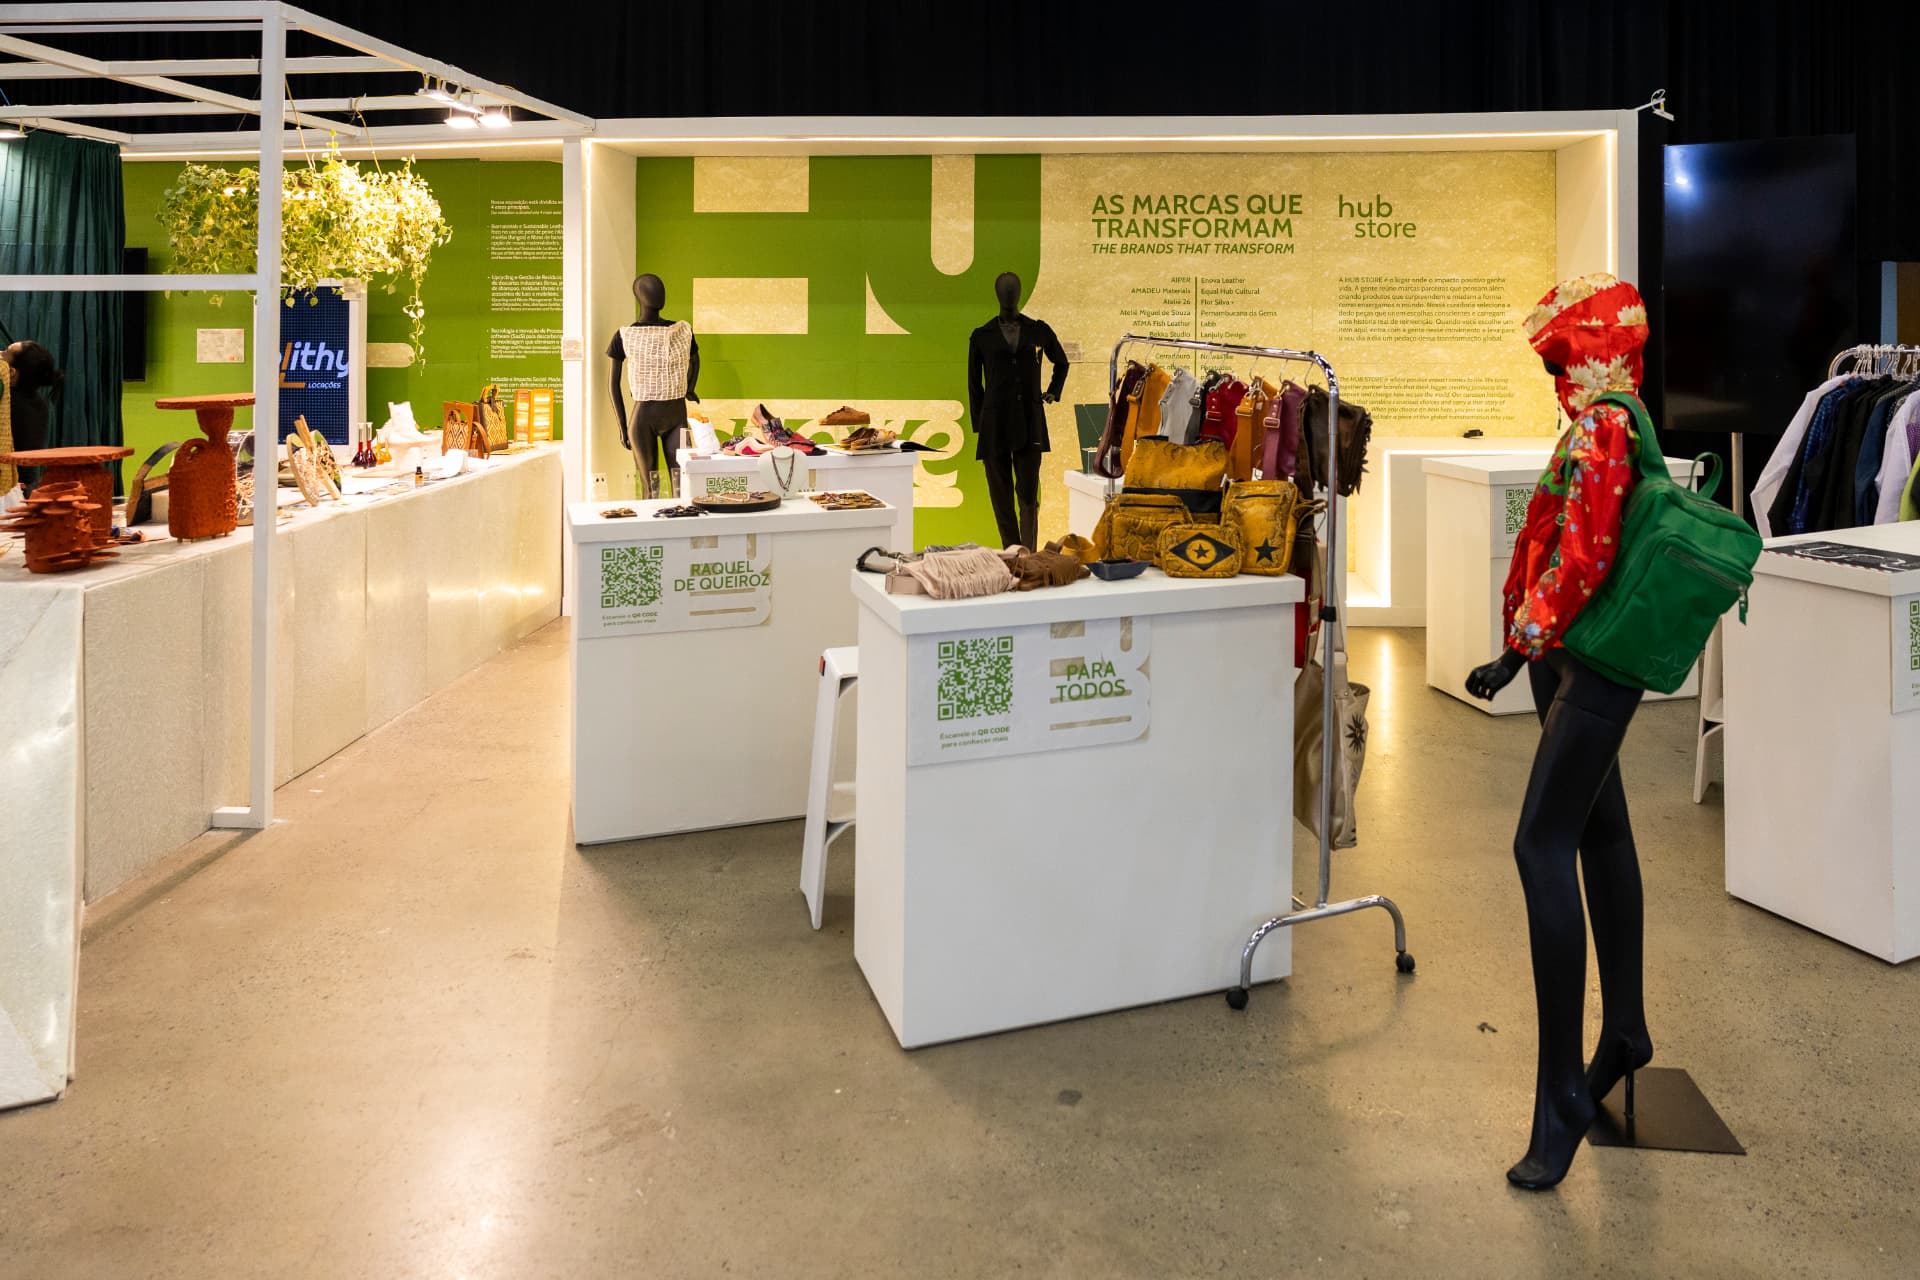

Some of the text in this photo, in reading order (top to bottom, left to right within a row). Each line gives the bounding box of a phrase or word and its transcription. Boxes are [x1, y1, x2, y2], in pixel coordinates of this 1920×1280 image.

[1092, 194, 1302, 215] AS MARCAS QUE
[1338, 194, 1392, 217] hub
[1092, 218, 1292, 238] TRANSFORMAM
[1354, 220, 1416, 238] store
[1092, 244, 1294, 254] THE BRANDS THAT TRANSFORM
[690, 561, 754, 576] RAQUEL
[674, 573, 770, 592] DE QUEIROZ
[1066, 660, 1116, 681] PARA
[1056, 679, 1126, 702] TODOS
